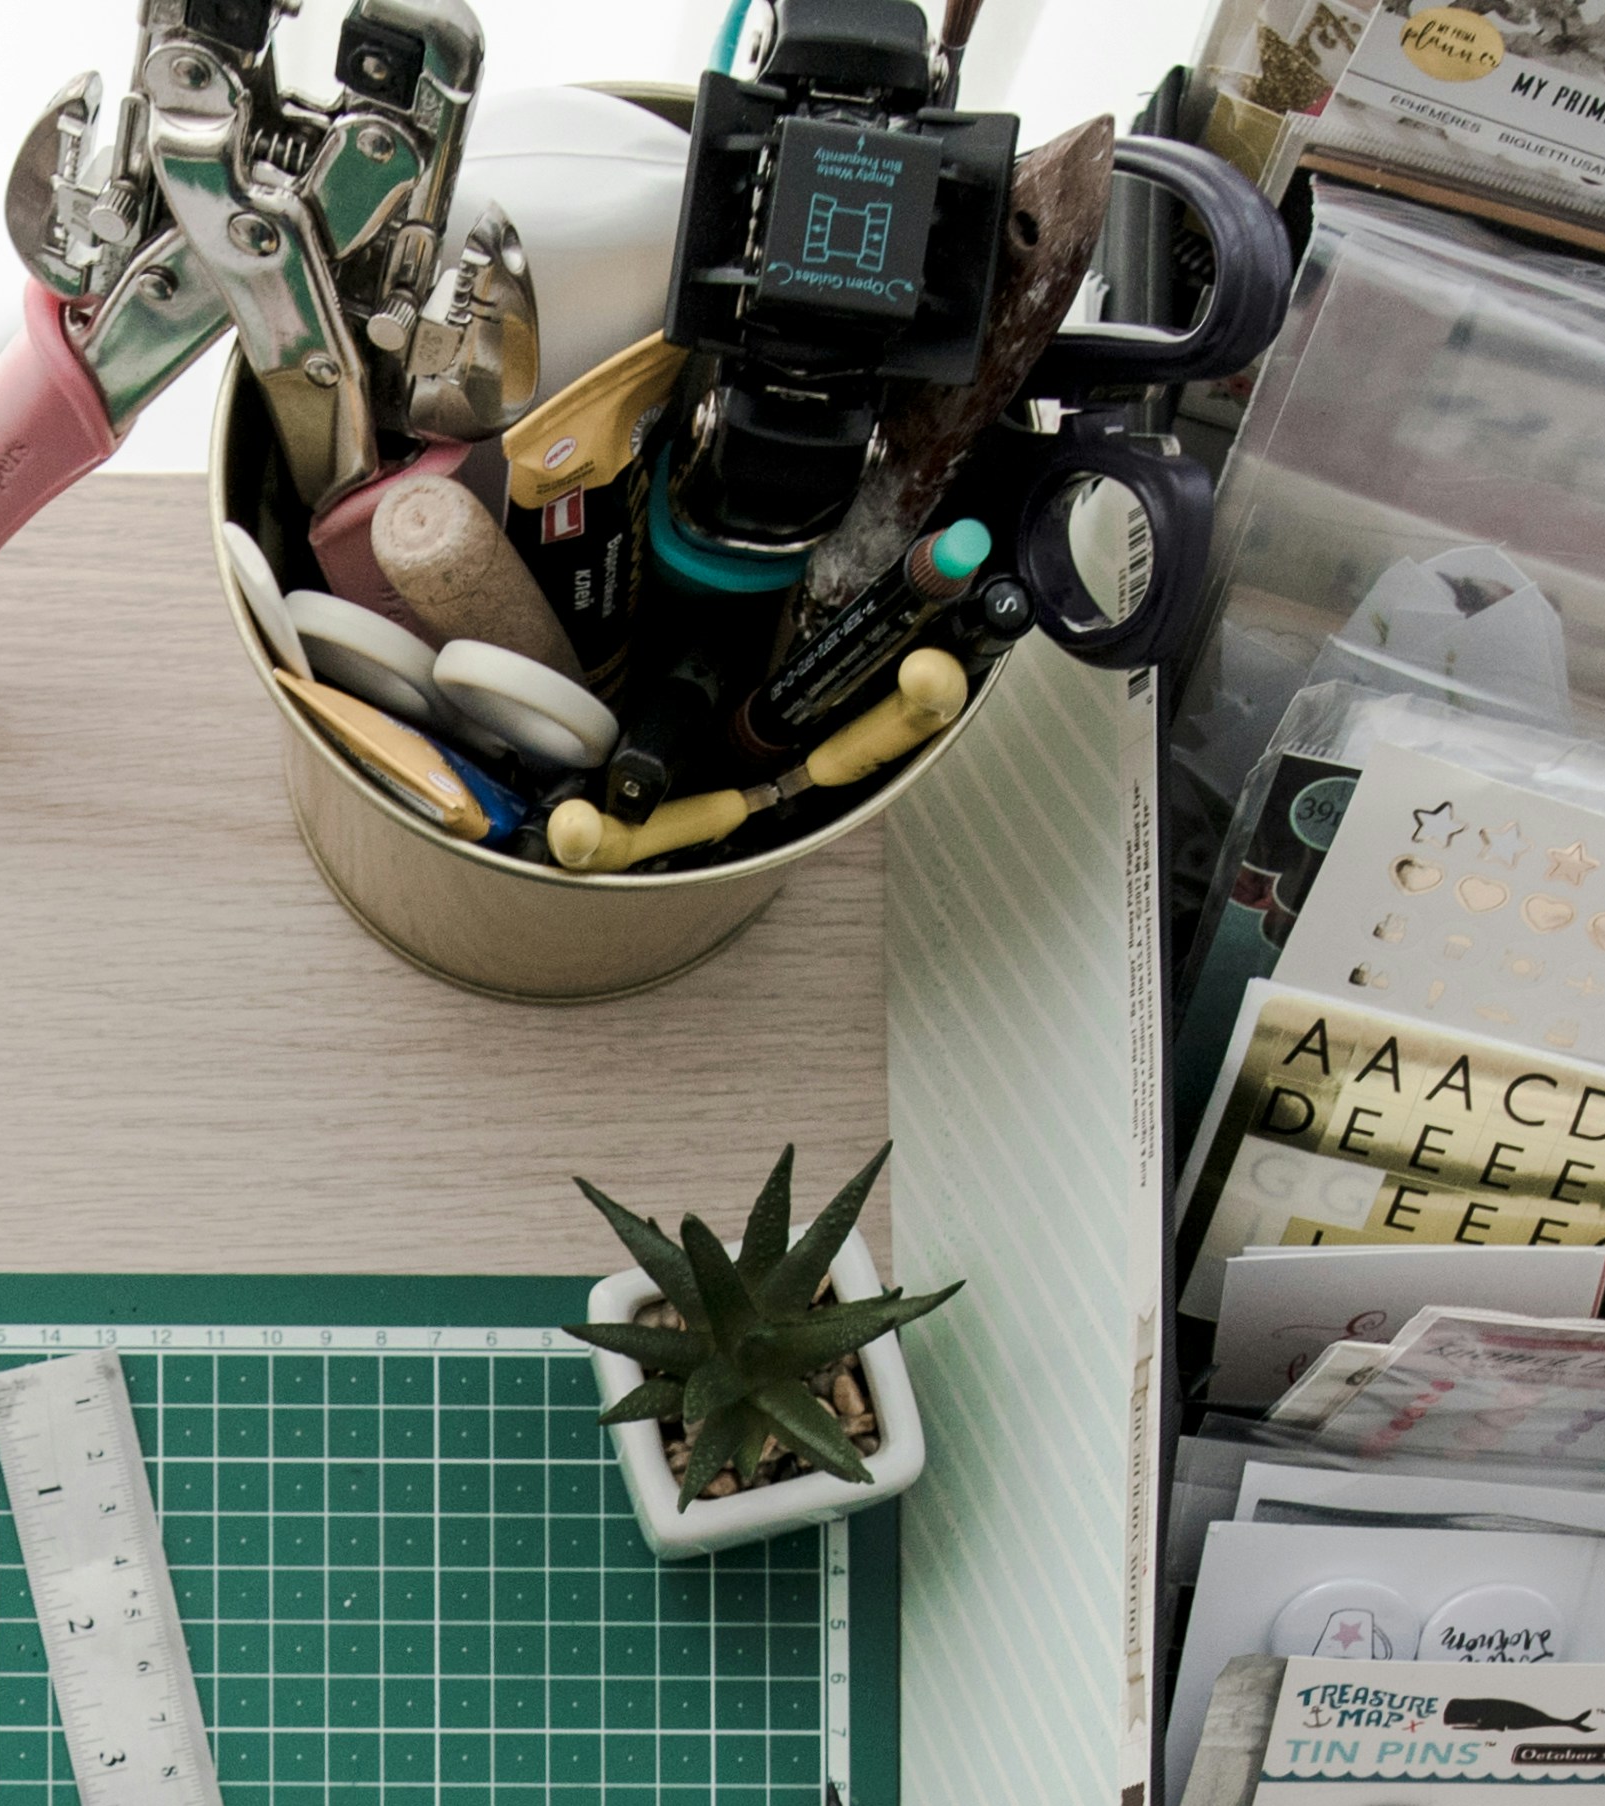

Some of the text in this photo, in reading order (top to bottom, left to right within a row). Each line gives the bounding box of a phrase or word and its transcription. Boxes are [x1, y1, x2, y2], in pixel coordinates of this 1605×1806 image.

[1512, 72, 1548, 101] MY
[813, 147, 903, 173] Bin Frequently
[816, 164, 895, 187] Empty Waste
[794, 270, 885, 294] Open Guides
[41, 1329, 61, 1345] 14
[260, 1329, 282, 1345] 10
[37, 1484, 63, 1496] 1
[67, 1617, 95, 1635] 2
[99, 1749, 127, 1769] 3
[1297, 1683, 1440, 1718] TREASURE
[1336, 1709, 1406, 1730] MAP
[1285, 1739, 1483, 1765] TIN PINS
[1520, 1747, 1596, 1764] October
